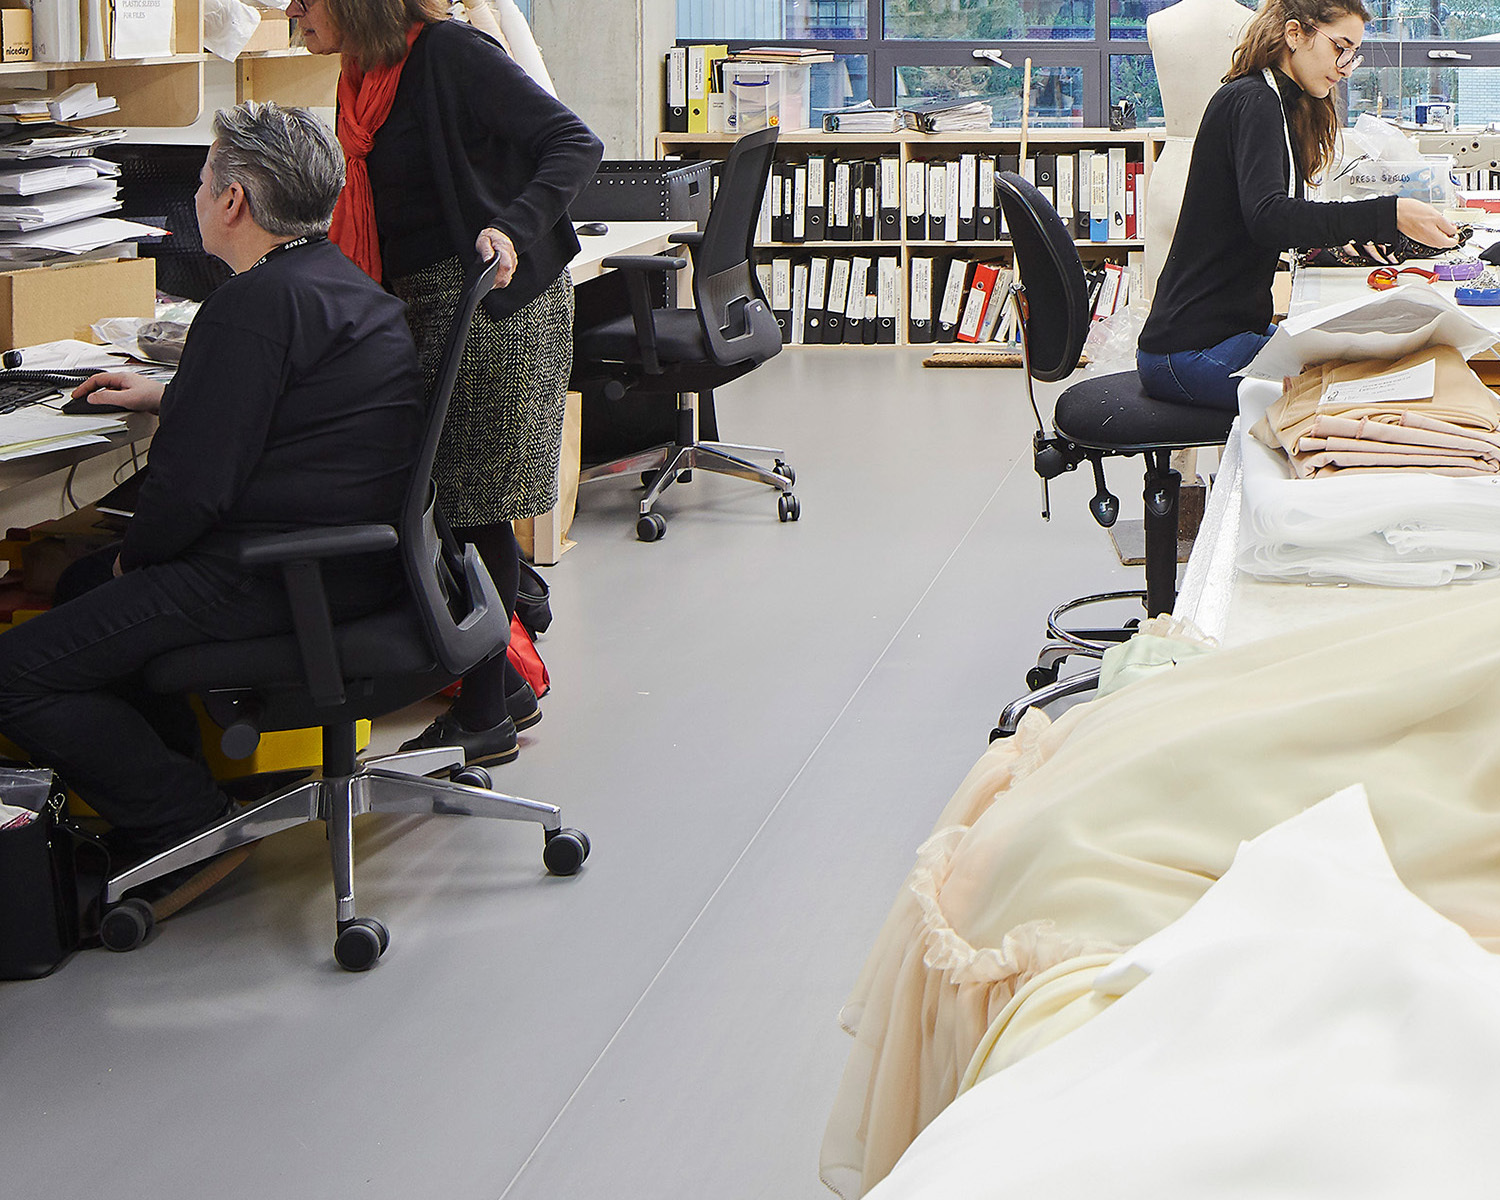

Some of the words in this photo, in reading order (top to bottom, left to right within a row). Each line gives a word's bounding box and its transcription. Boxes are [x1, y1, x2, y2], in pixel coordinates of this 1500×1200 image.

[5, 46, 30, 56] niceday
[1349, 174, 1377, 185] DRESS
[284, 236, 308, 250] STAFF
